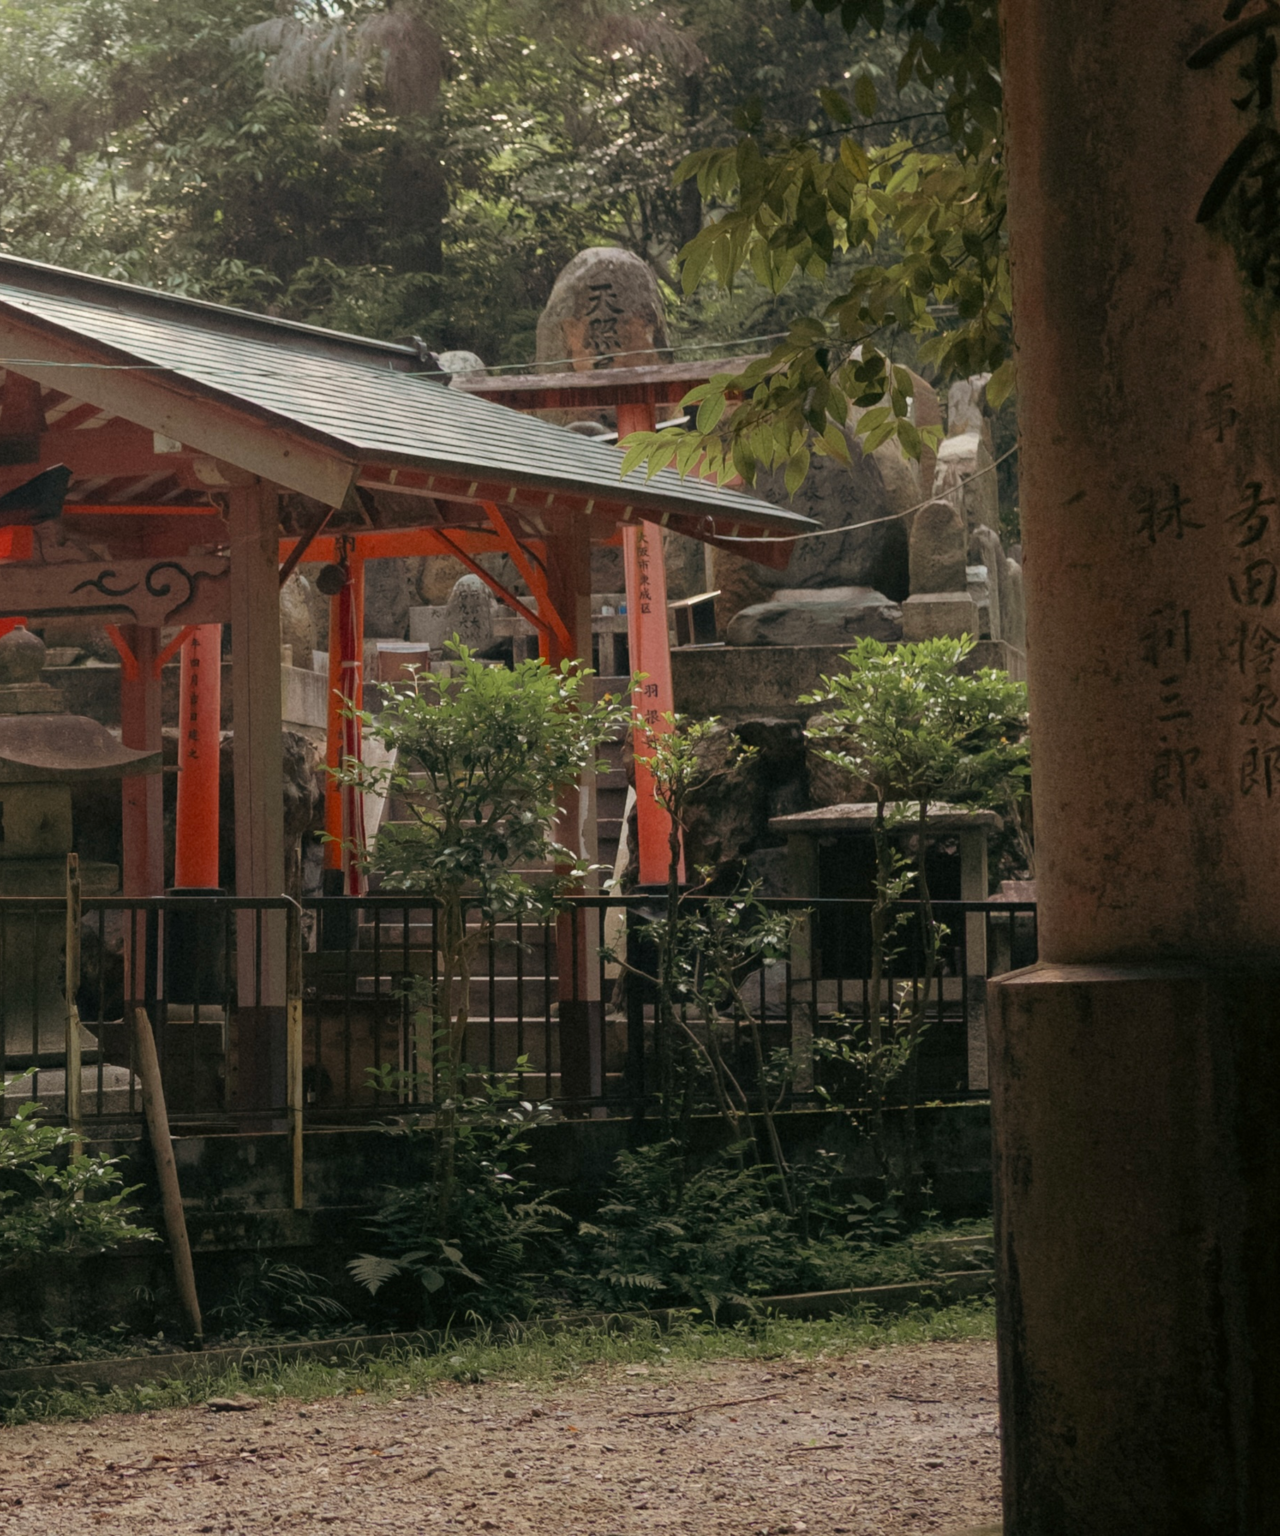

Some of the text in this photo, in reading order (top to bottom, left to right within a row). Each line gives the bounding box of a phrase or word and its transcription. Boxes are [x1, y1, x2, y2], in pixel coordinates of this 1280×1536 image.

[636, 531, 653, 614] 大阪市東成区
[187, 626, 201, 760] 年四月吉日建之
